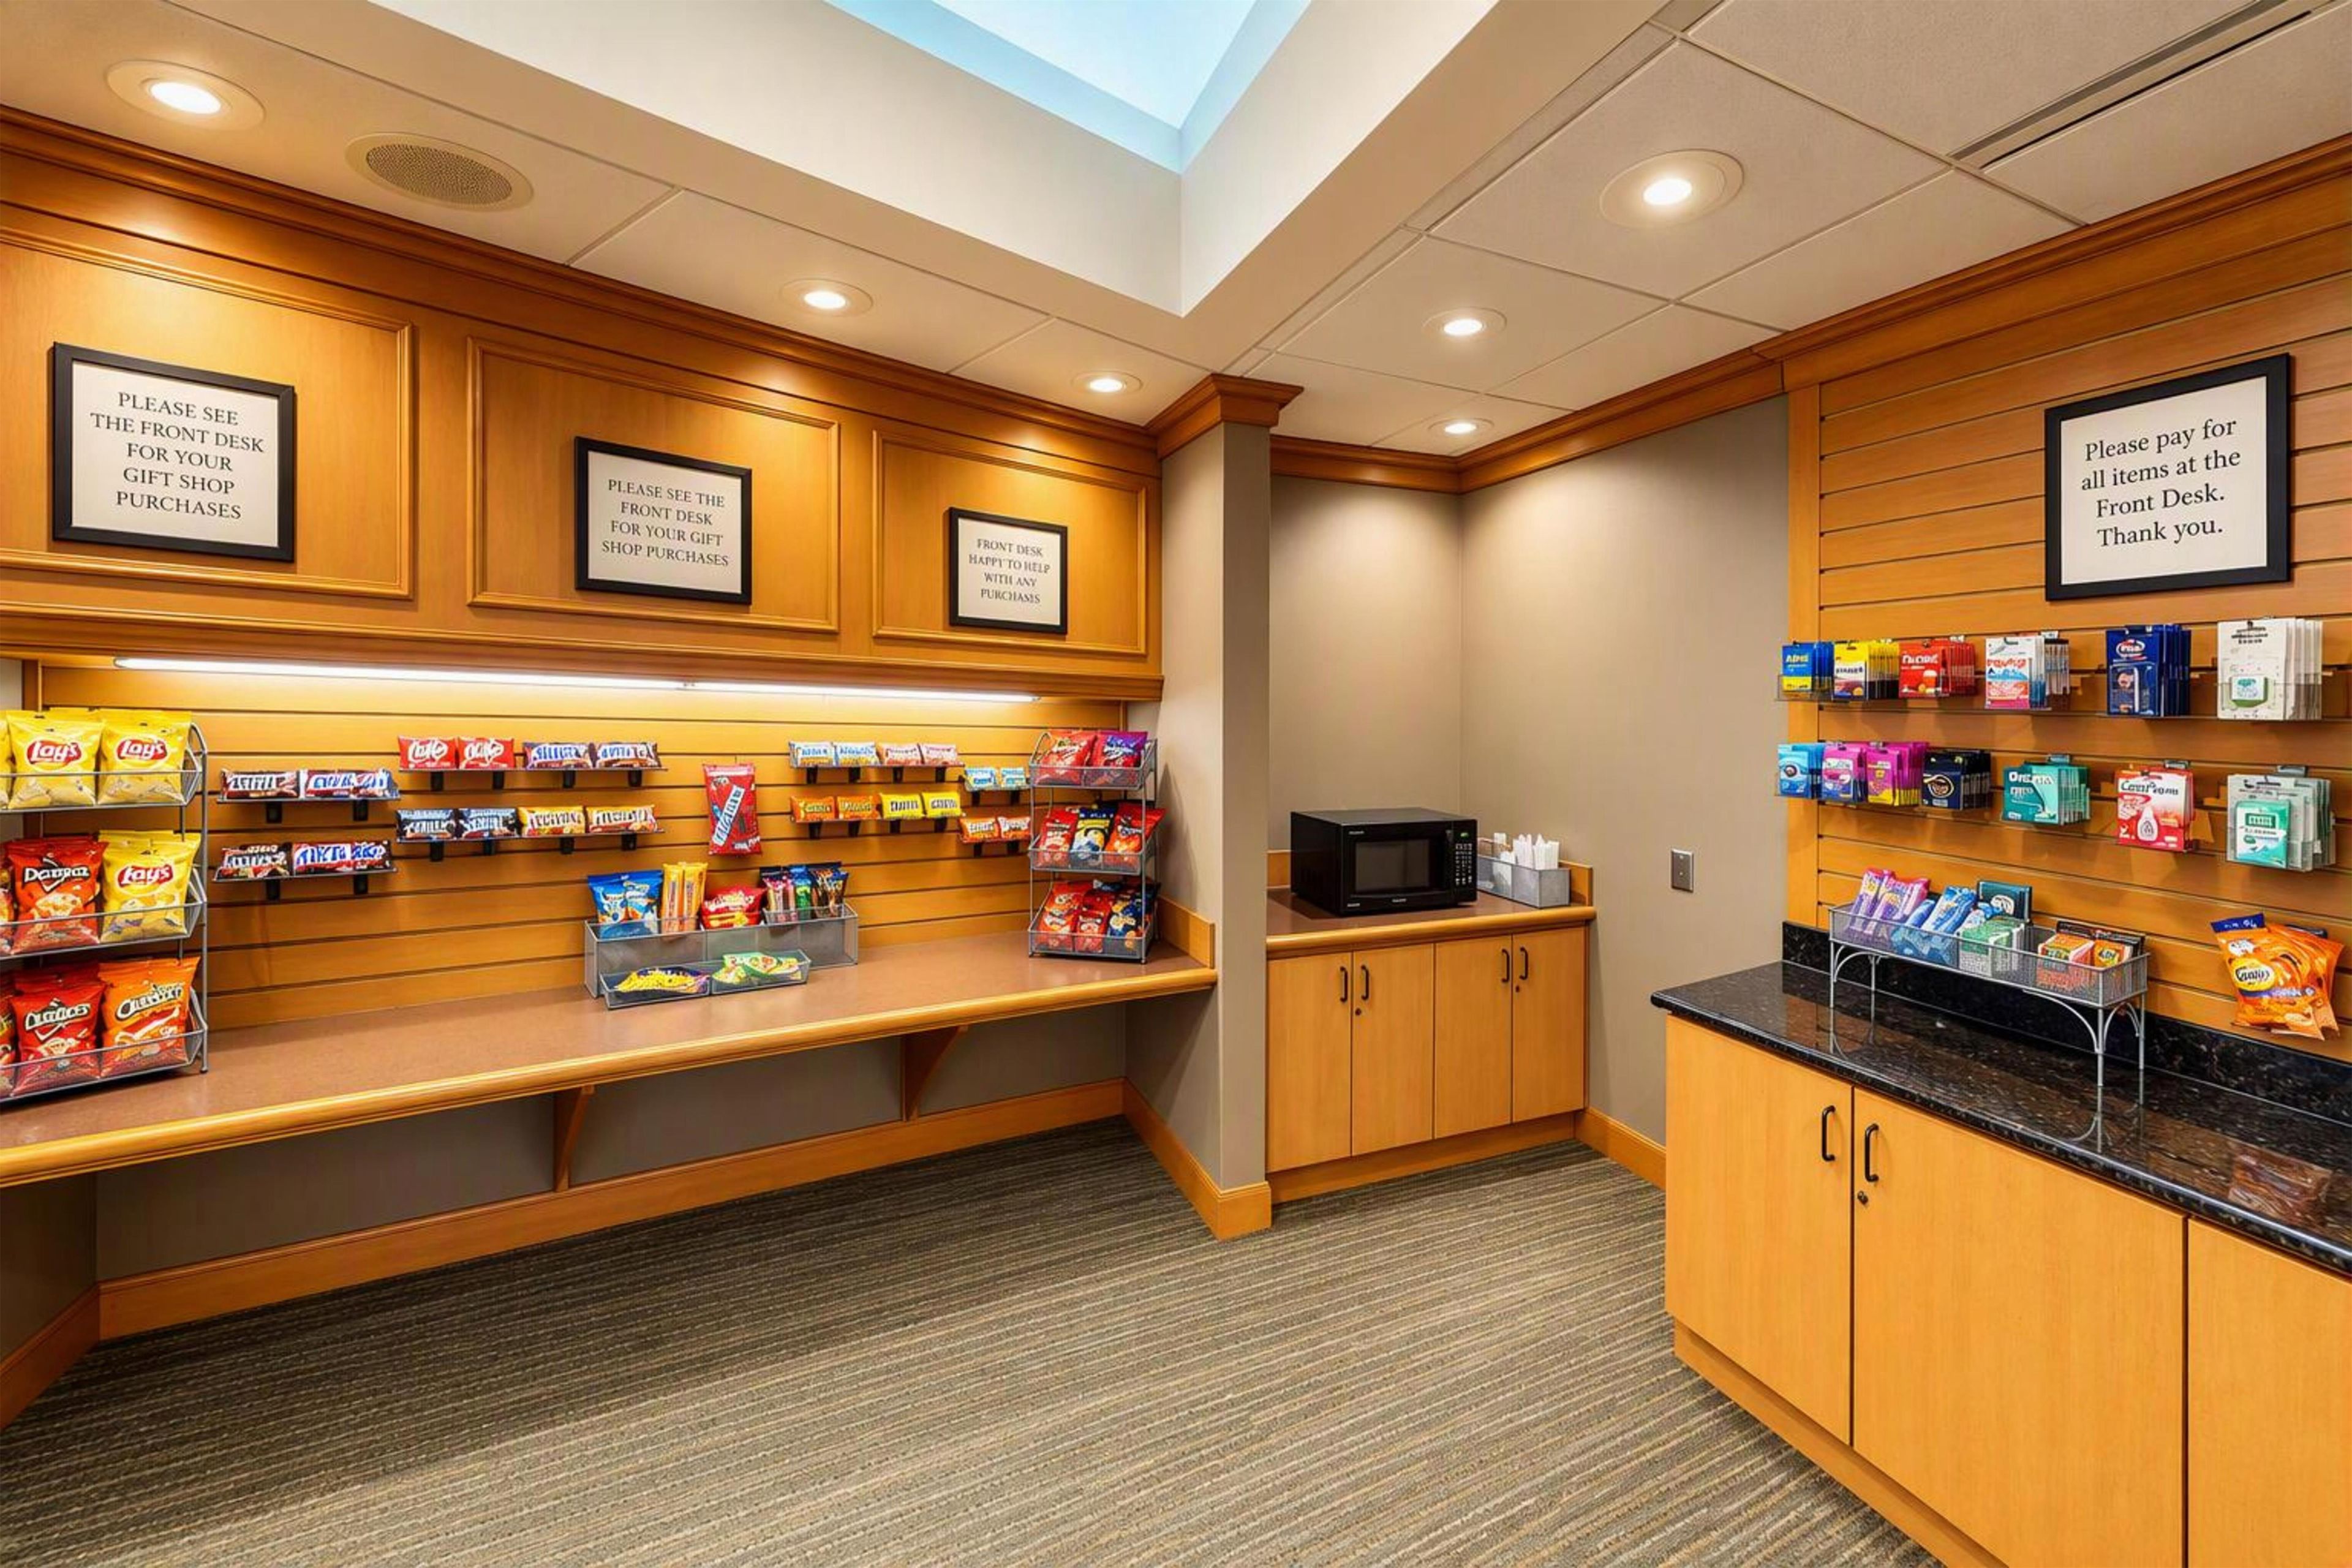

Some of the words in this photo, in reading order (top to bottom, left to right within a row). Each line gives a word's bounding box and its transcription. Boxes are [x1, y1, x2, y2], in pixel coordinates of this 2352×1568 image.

[118, 392, 197, 418] PLEASE
[203, 407, 239, 426] SEE
[90, 412, 135, 433] THE
[141, 421, 209, 443] FRONT
[215, 432, 264, 453] DESK
[2084, 437, 2149, 461] Please
[2156, 428, 2195, 453] pay
[2202, 418, 2237, 440] for
[127, 442, 169, 463] FOR
[175, 450, 233, 471] YOUR
[2081, 468, 2105, 491] all
[2112, 464, 2169, 486] items
[2176, 456, 2196, 475] at
[2204, 450, 2241, 471] the
[123, 467, 173, 487] GIFT
[179, 475, 235, 494] SHOP
[608, 479, 662, 499] PLEASE
[667, 488, 692, 503] SEE
[695, 492, 725, 508] THE
[116, 491, 241, 519] PURCHASES
[621, 502, 672, 520] FRONT
[676, 509, 713, 526] DESK
[2096, 496, 2154, 518] Front
[2162, 483, 2225, 509] Desk.
[611, 521, 641, 537] FOR
[646, 526, 686, 541] YOUR
[690, 532, 723, 546] GIFT
[2097, 522, 2166, 547] Thank
[2174, 519, 2223, 544] you.
[601, 540, 643, 556] SHOP
[647, 546, 729, 567] PURCHASES
[977, 538, 1013, 553] FRONT
[1016, 545, 1043, 557] DESK
[968, 554, 1005, 568] HAPPY
[1006, 559, 1022, 570] TO
[1024, 562, 1051, 574] HELP
[984, 572, 1013, 586] WITH
[1016, 577, 1037, 587] ANY
